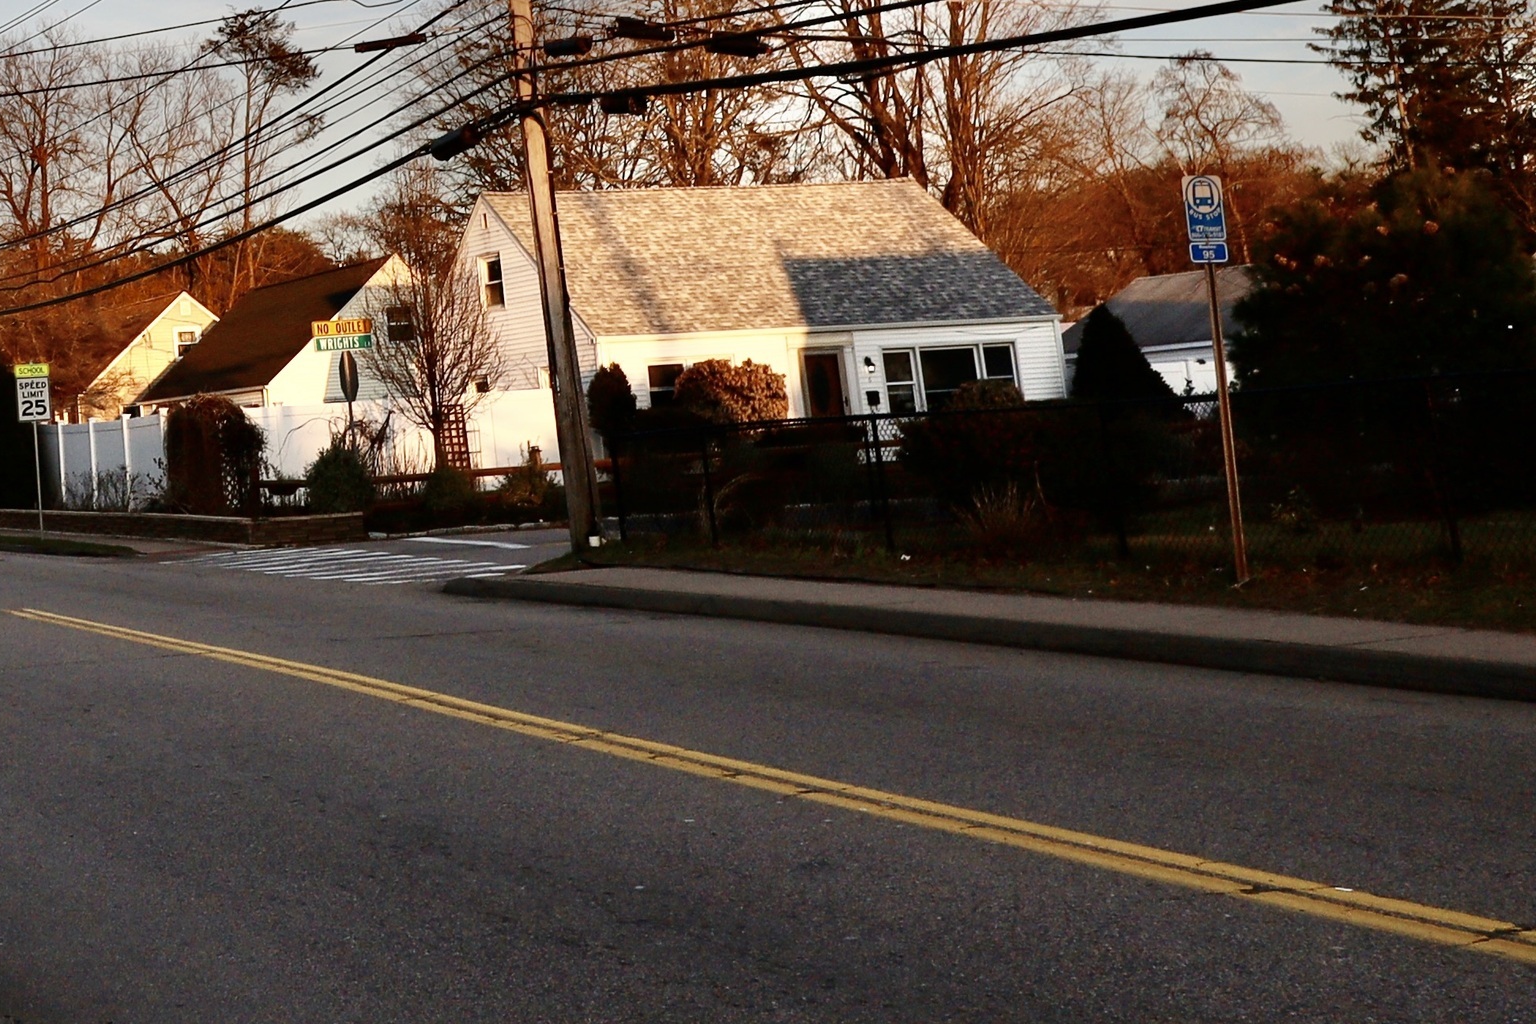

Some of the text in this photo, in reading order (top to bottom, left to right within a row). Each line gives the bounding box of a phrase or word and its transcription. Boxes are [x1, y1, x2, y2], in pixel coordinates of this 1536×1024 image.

[1189, 206, 1221, 220] BUS STOP
[1202, 250, 1215, 259] 95
[317, 323, 329, 335] NO
[319, 336, 360, 350] WRIGHTS
[19, 381, 46, 390] SPEED
[22, 390, 44, 398] LIMIT
[21, 399, 47, 417] 25
